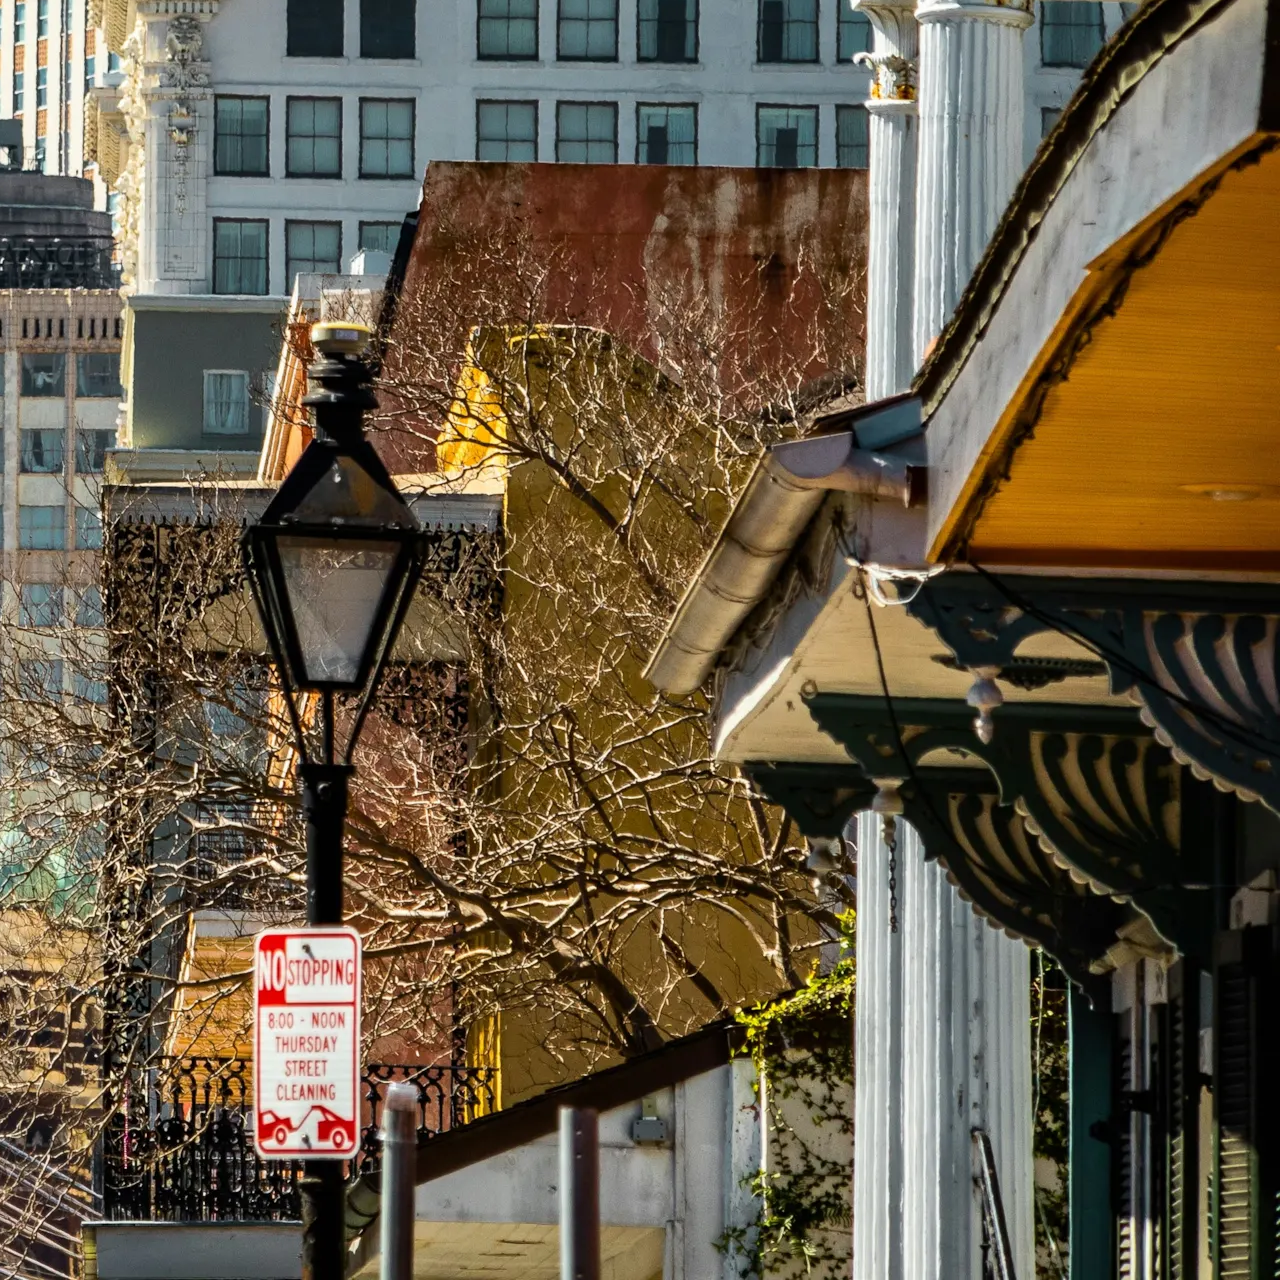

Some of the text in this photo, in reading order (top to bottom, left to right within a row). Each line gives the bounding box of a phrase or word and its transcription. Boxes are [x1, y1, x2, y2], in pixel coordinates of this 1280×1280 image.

[259, 950, 354, 991] NO STOPPING
[268, 1012, 294, 1029] 8:00
[311, 1012, 346, 1029] NOON
[275, 1036, 338, 1053] THURSDAY
[285, 1060, 328, 1077] STREET
[276, 1084, 336, 1101] CLEANING
